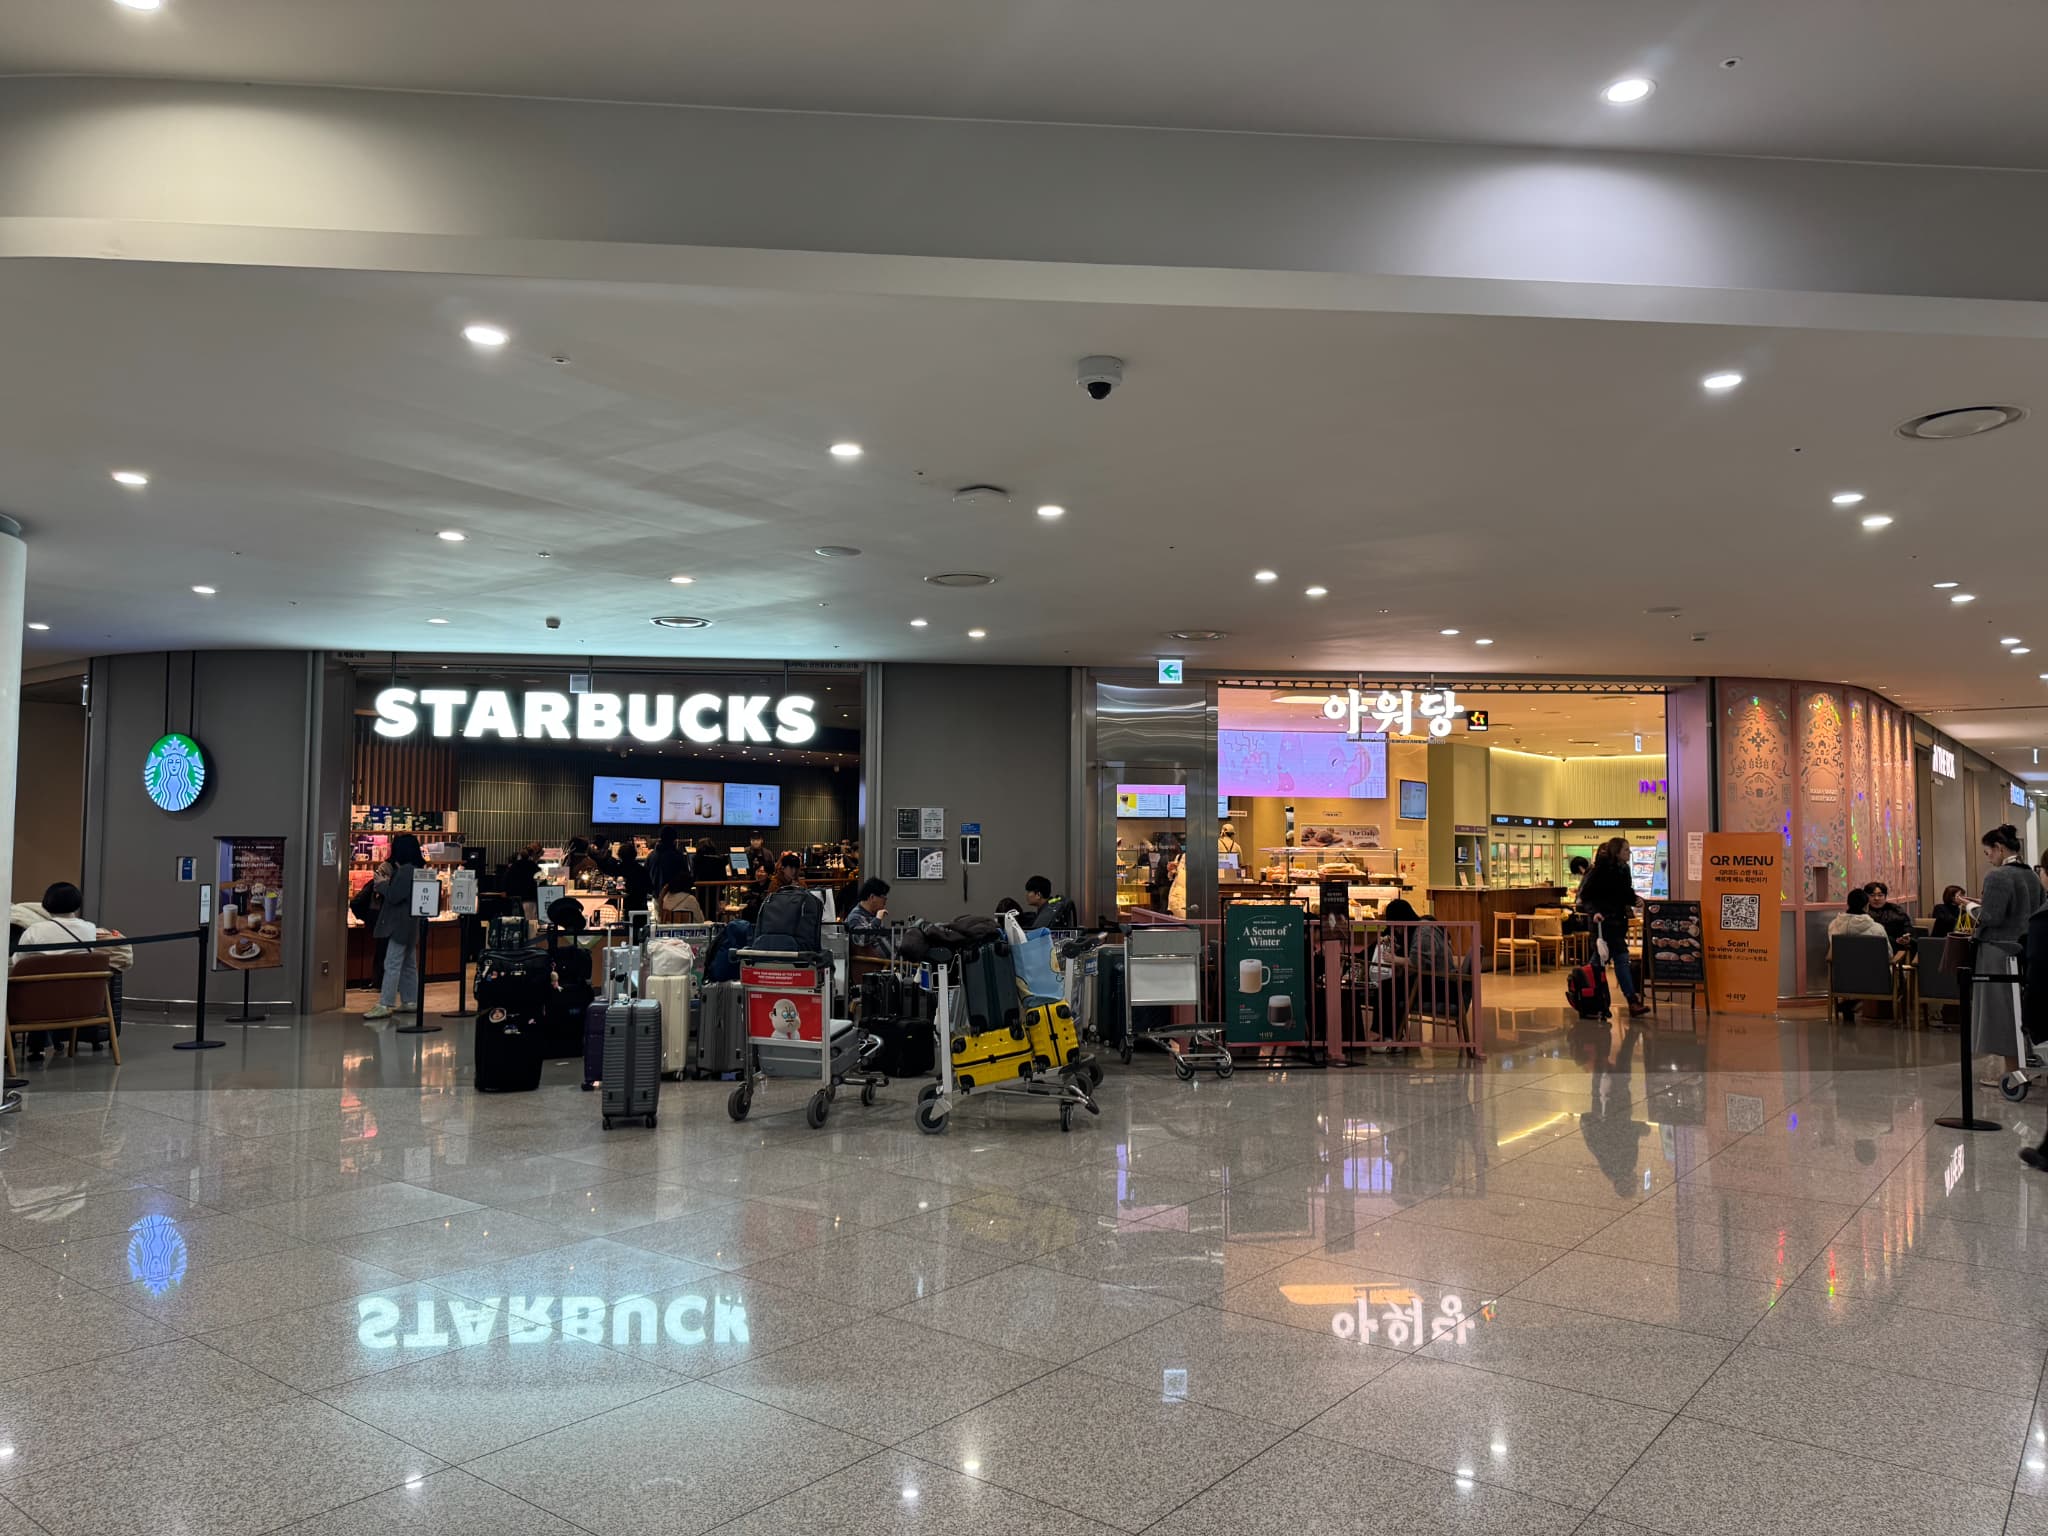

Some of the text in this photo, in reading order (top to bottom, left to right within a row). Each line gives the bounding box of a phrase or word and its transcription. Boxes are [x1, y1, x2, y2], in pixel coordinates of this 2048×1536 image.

[374, 688, 817, 743] STARBUCKS
[1323, 688, 1465, 737] 아워당
[1710, 855, 1774, 866] QR MENU
[1243, 925, 1288, 936] A Scent of
[1250, 937, 1281, 947] Winter
[1727, 940, 1750, 948] Scan!
